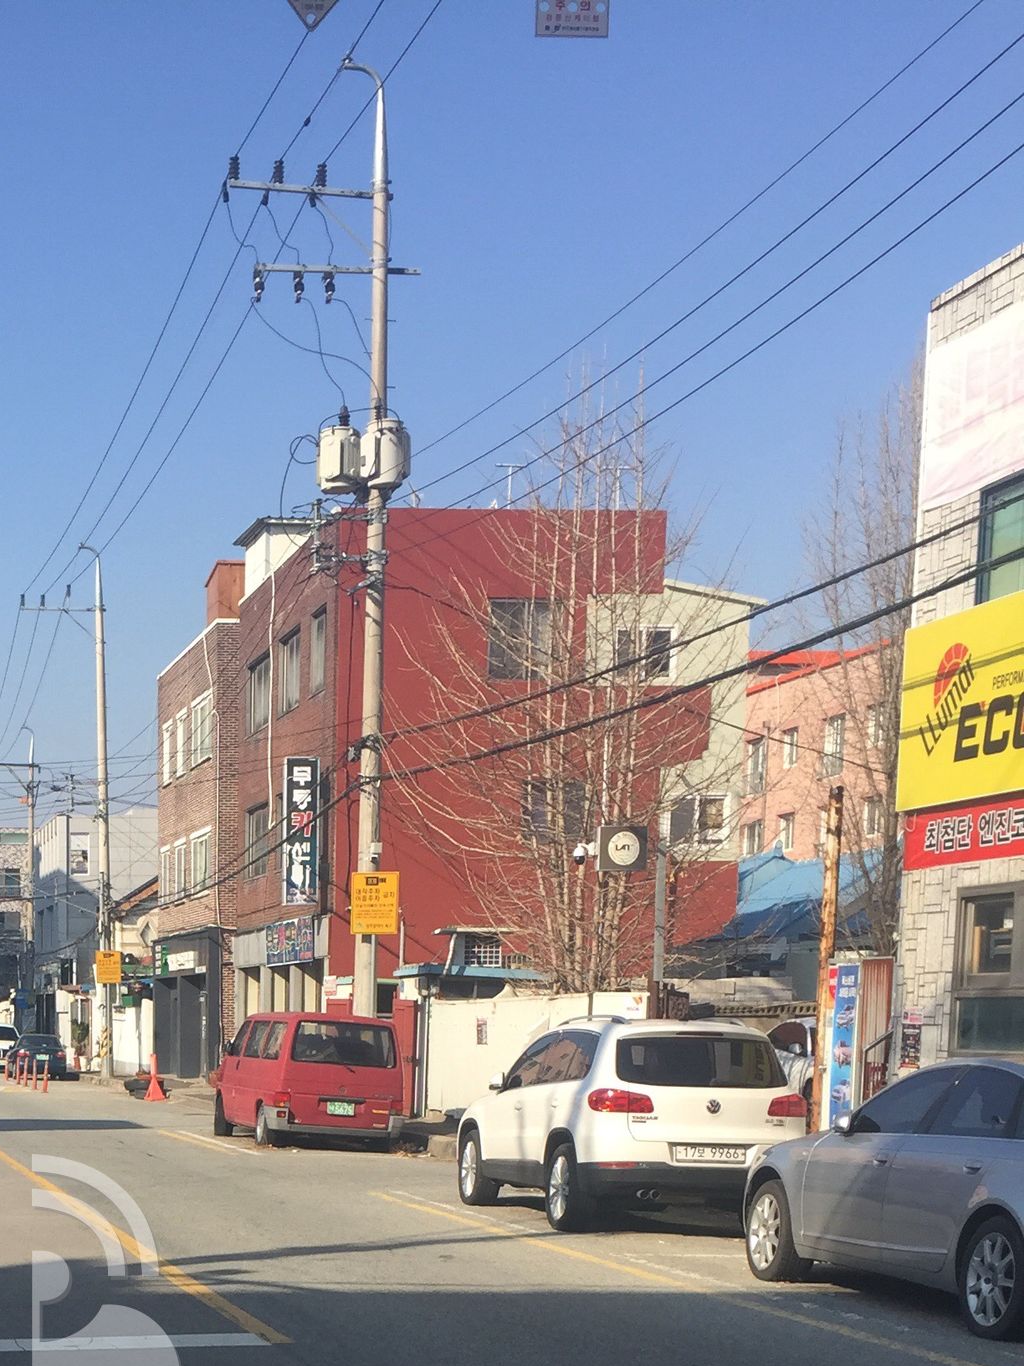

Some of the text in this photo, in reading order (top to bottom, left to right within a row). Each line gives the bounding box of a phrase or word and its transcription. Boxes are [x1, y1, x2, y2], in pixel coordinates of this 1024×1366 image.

[918, 653, 976, 757] LLumar
[924, 812, 973, 853] 최첨단
[710, 1146, 740, 1160] 9966
